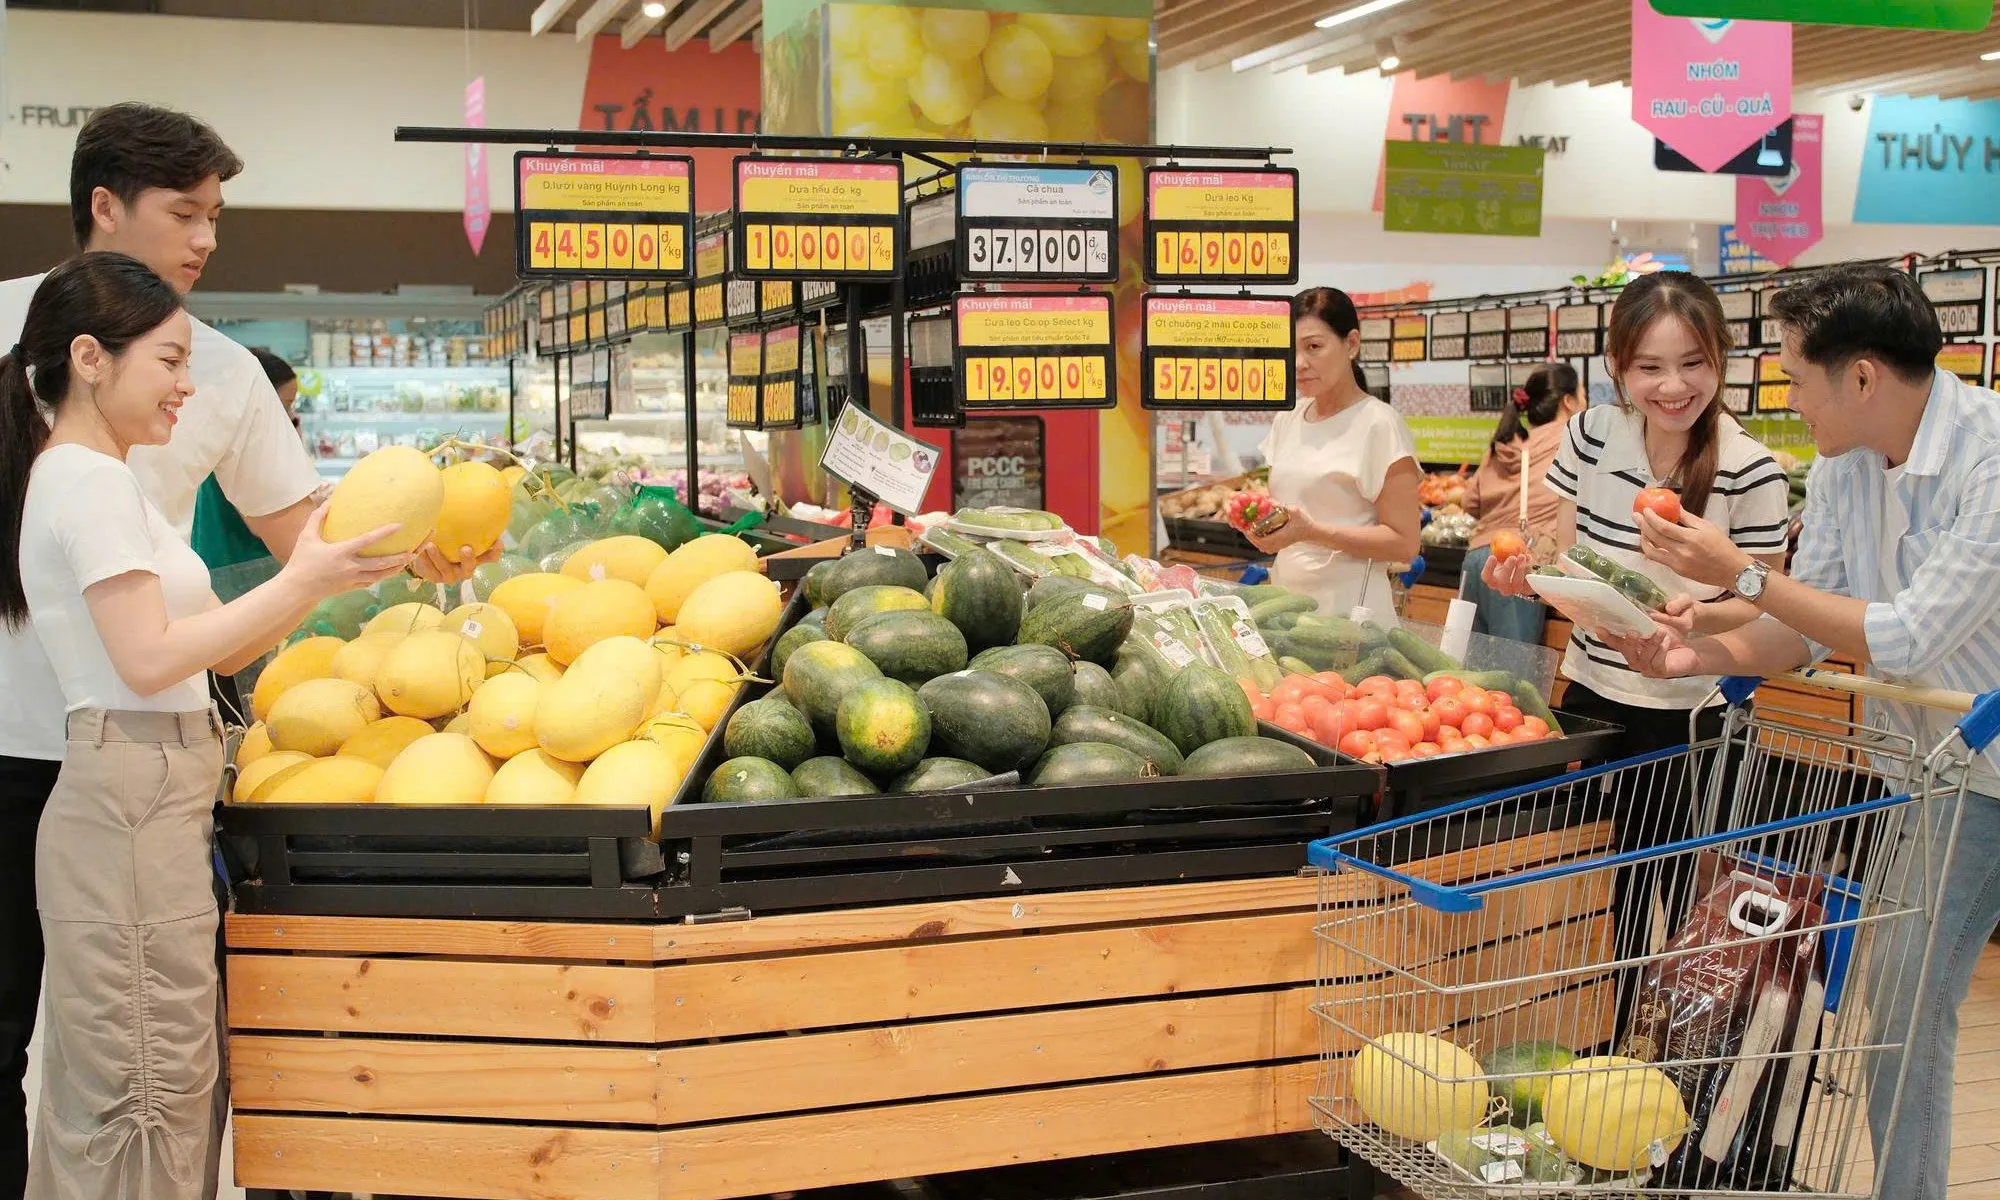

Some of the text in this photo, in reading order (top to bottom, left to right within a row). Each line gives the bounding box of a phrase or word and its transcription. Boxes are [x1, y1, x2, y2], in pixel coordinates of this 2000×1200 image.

[1688, 59, 1739, 79] NHÓM
[1652, 100, 1687, 116] RAU
[1700, 94, 1724, 116] CỦ
[1736, 92, 1772, 116] QUẢ
[1876, 124, 1973, 170] THỦY
[525, 159, 605, 174] Khuyến mãi
[744, 162, 818, 178] Khuyến mãi
[577, 182, 602, 192] vàng
[640, 182, 665, 193] Long
[668, 183, 680, 194] kg
[1155, 173, 1223, 187] Khuyến mãi
[788, 185, 809, 194] Dưa
[850, 186, 862, 196] kg
[1041, 184, 1064, 193] chua
[1241, 194, 1254, 203] Kg
[535, 229, 654, 262] 44.500
[754, 230, 865, 262] 10.000
[973, 234, 1081, 264] 37.900
[1163, 237, 1264, 267] 16.900
[961, 297, 1032, 312] Khuyến mãi
[1149, 299, 1216, 313] Khuyến mãi
[1053, 318, 1080, 327] Select
[1083, 317, 1094, 327] kg
[1204, 320, 1209, 328] 2
[976, 363, 1080, 394] 19.900
[1159, 364, 1261, 393] 57.500
[968, 456, 1025, 476] PCCC
